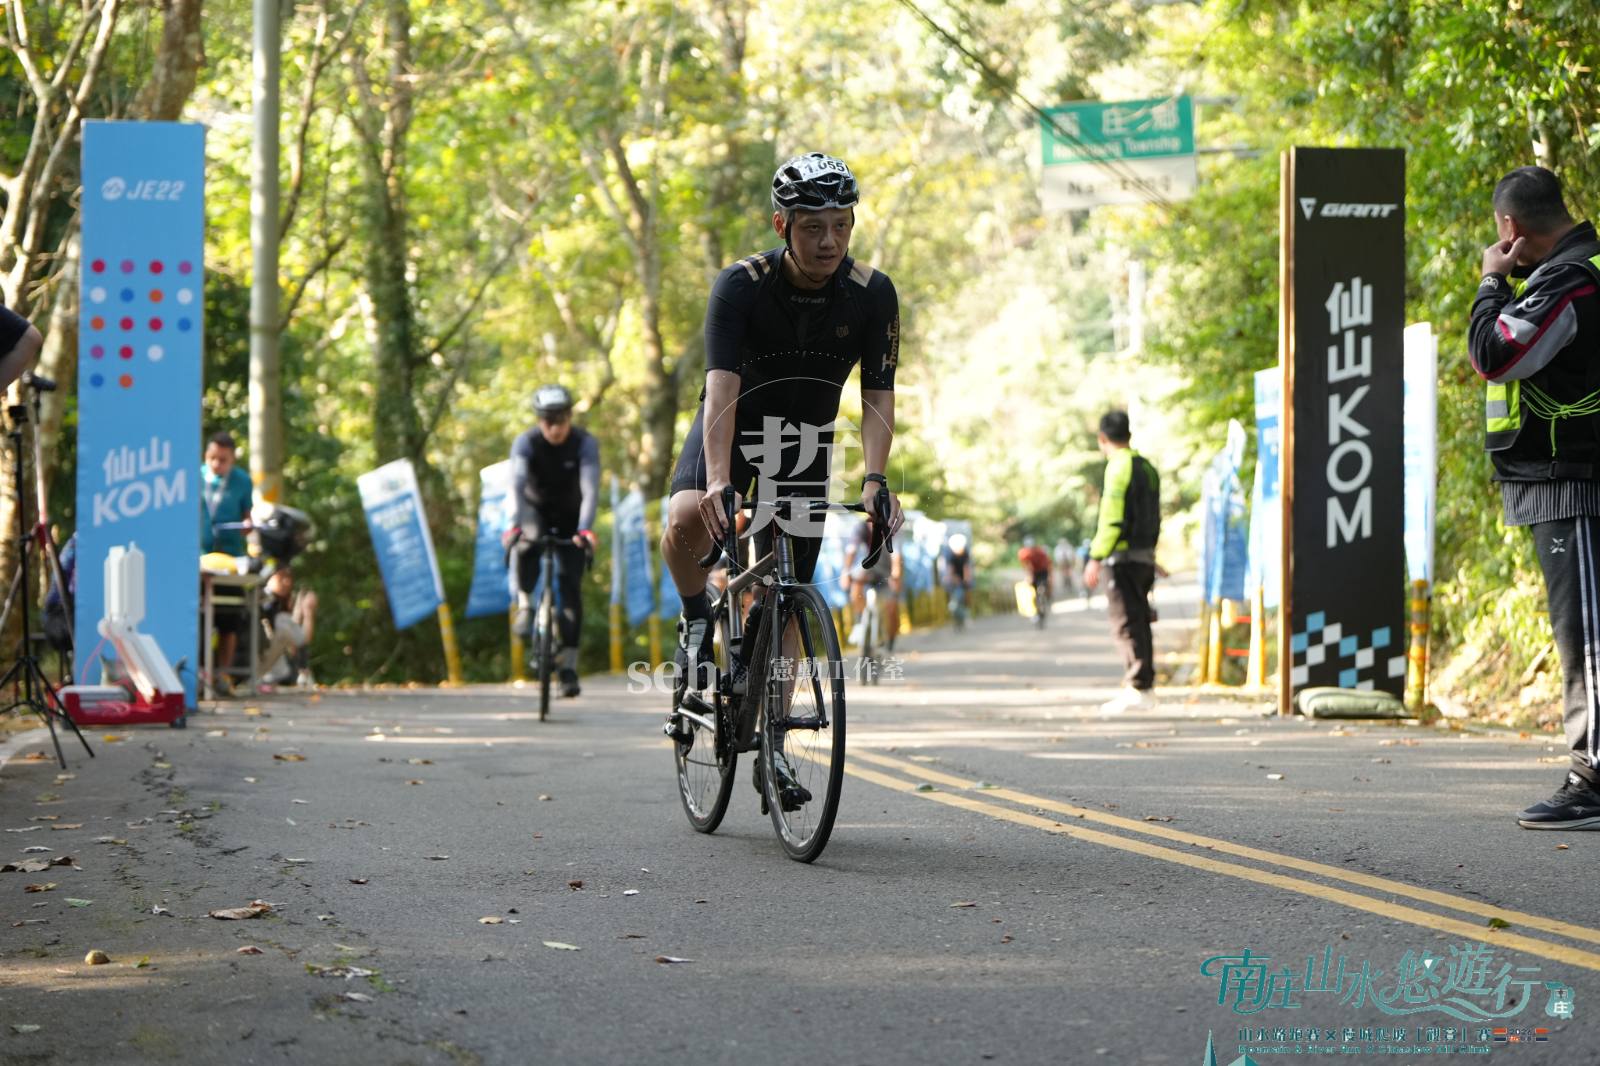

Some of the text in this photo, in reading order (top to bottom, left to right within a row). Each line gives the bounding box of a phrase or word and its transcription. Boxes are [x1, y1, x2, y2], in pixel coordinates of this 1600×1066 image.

[126, 180, 185, 200] JE22
[1320, 203, 1398, 218] GIANT
[102, 436, 171, 488] 仙山
[92, 468, 186, 528] KOM
